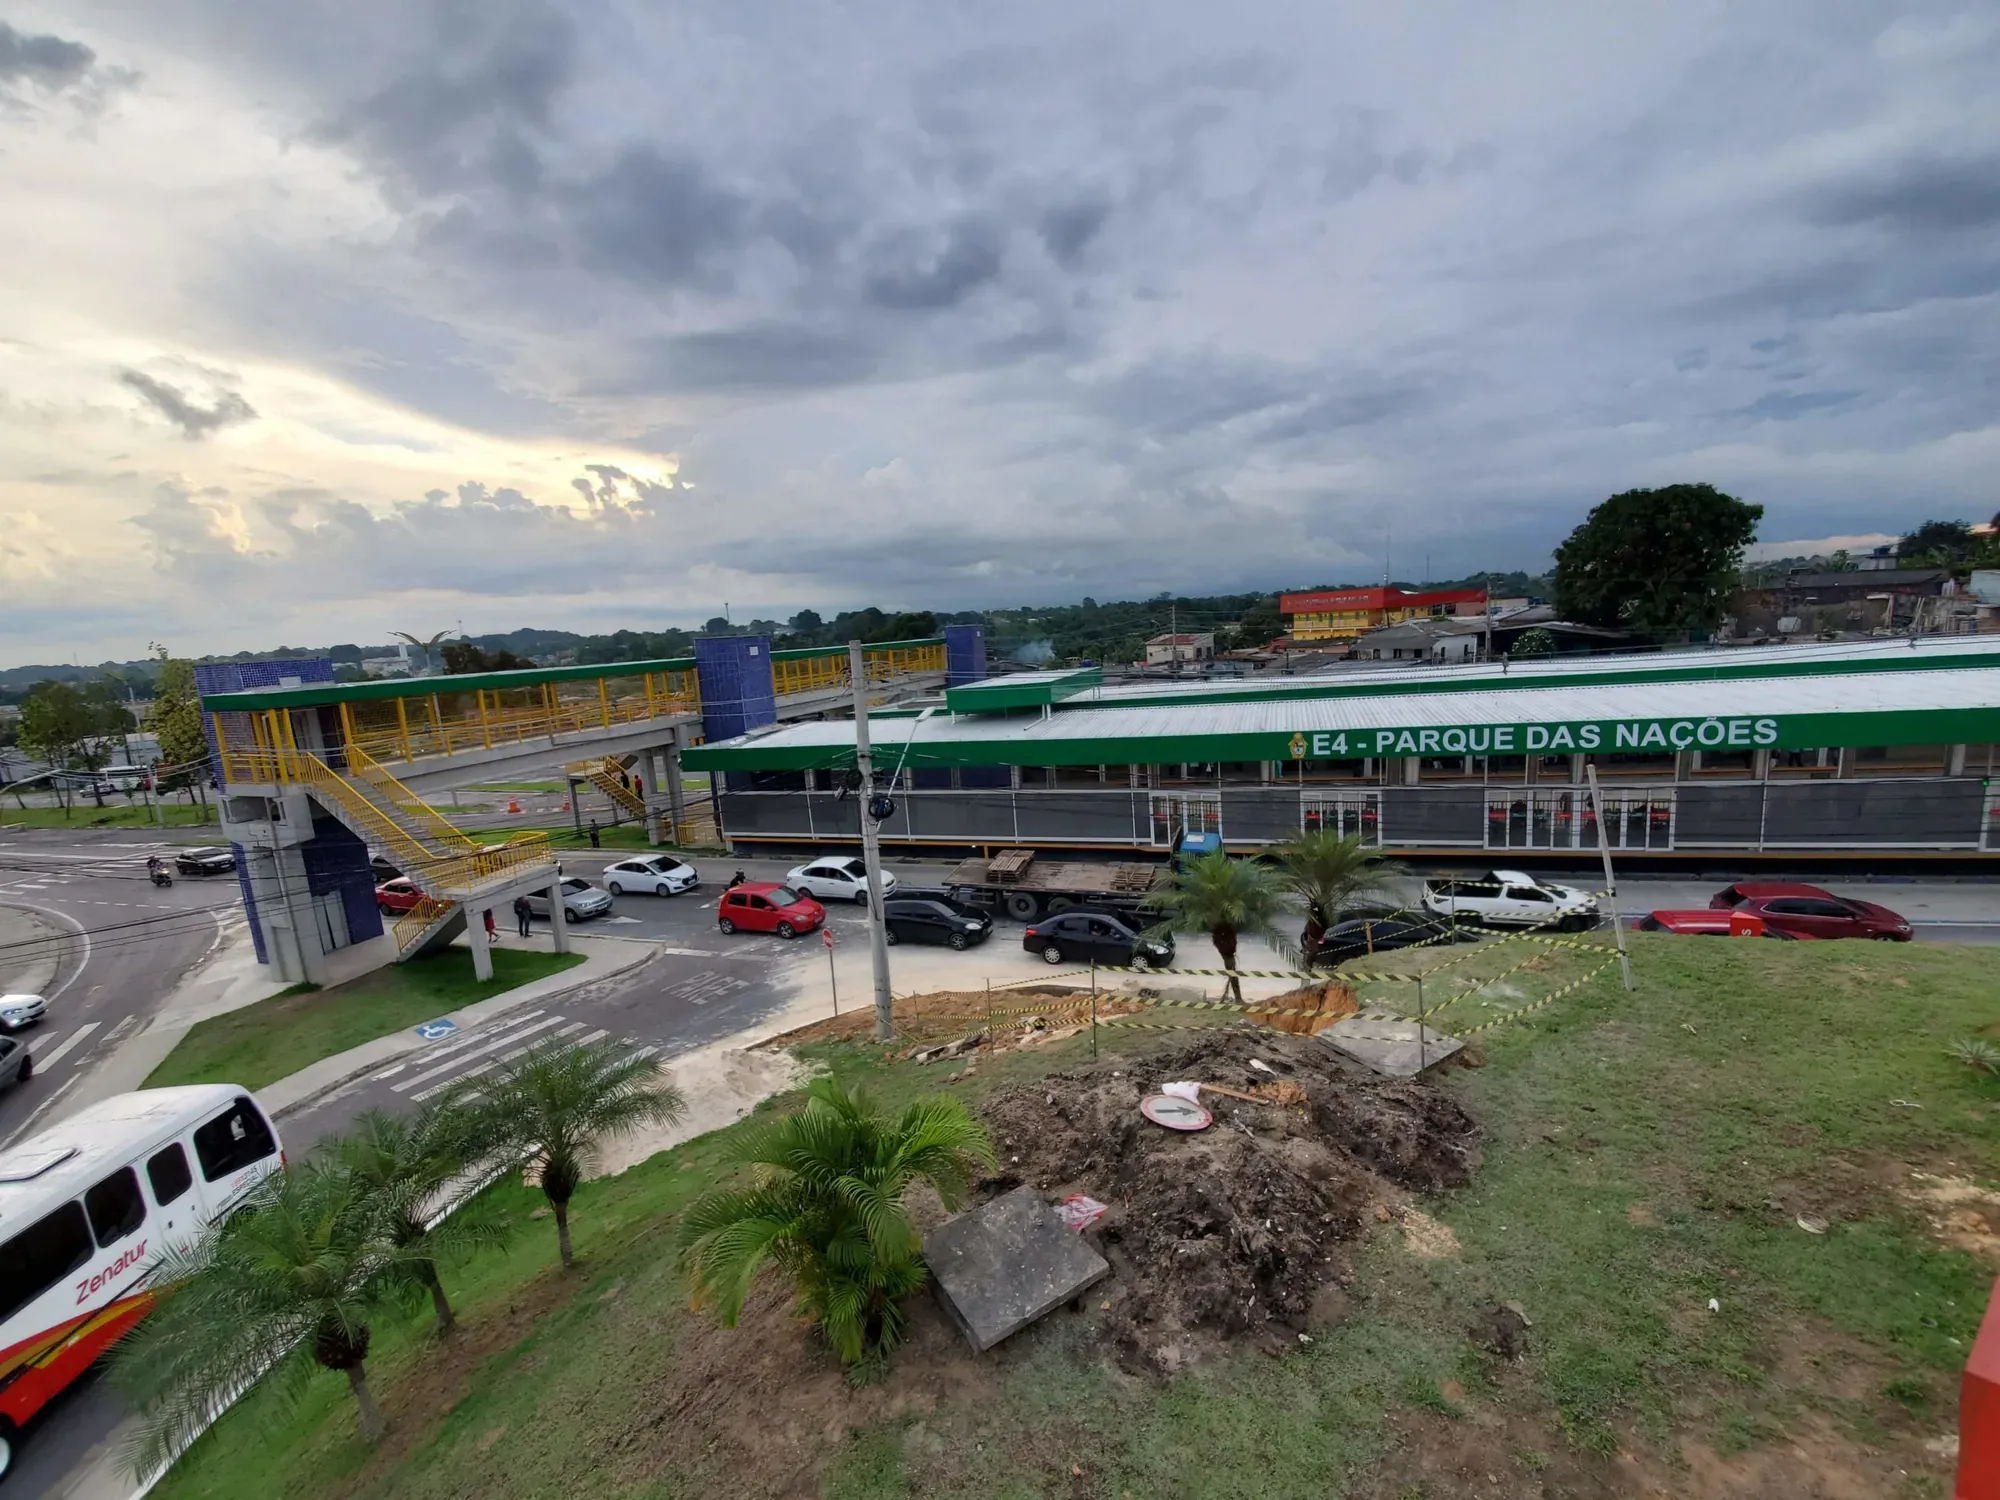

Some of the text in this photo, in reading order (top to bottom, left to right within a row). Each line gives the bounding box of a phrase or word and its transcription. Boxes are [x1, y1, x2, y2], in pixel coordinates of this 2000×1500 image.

[1313, 733, 1348, 755] E4
[1376, 727, 1514, 753] PARQUE
[1526, 724, 1600, 749] DAS
[1616, 717, 1777, 750] NAÇÕES
[661, 971, 750, 1005] PARE
[76, 1239, 148, 1306] Zenatur
